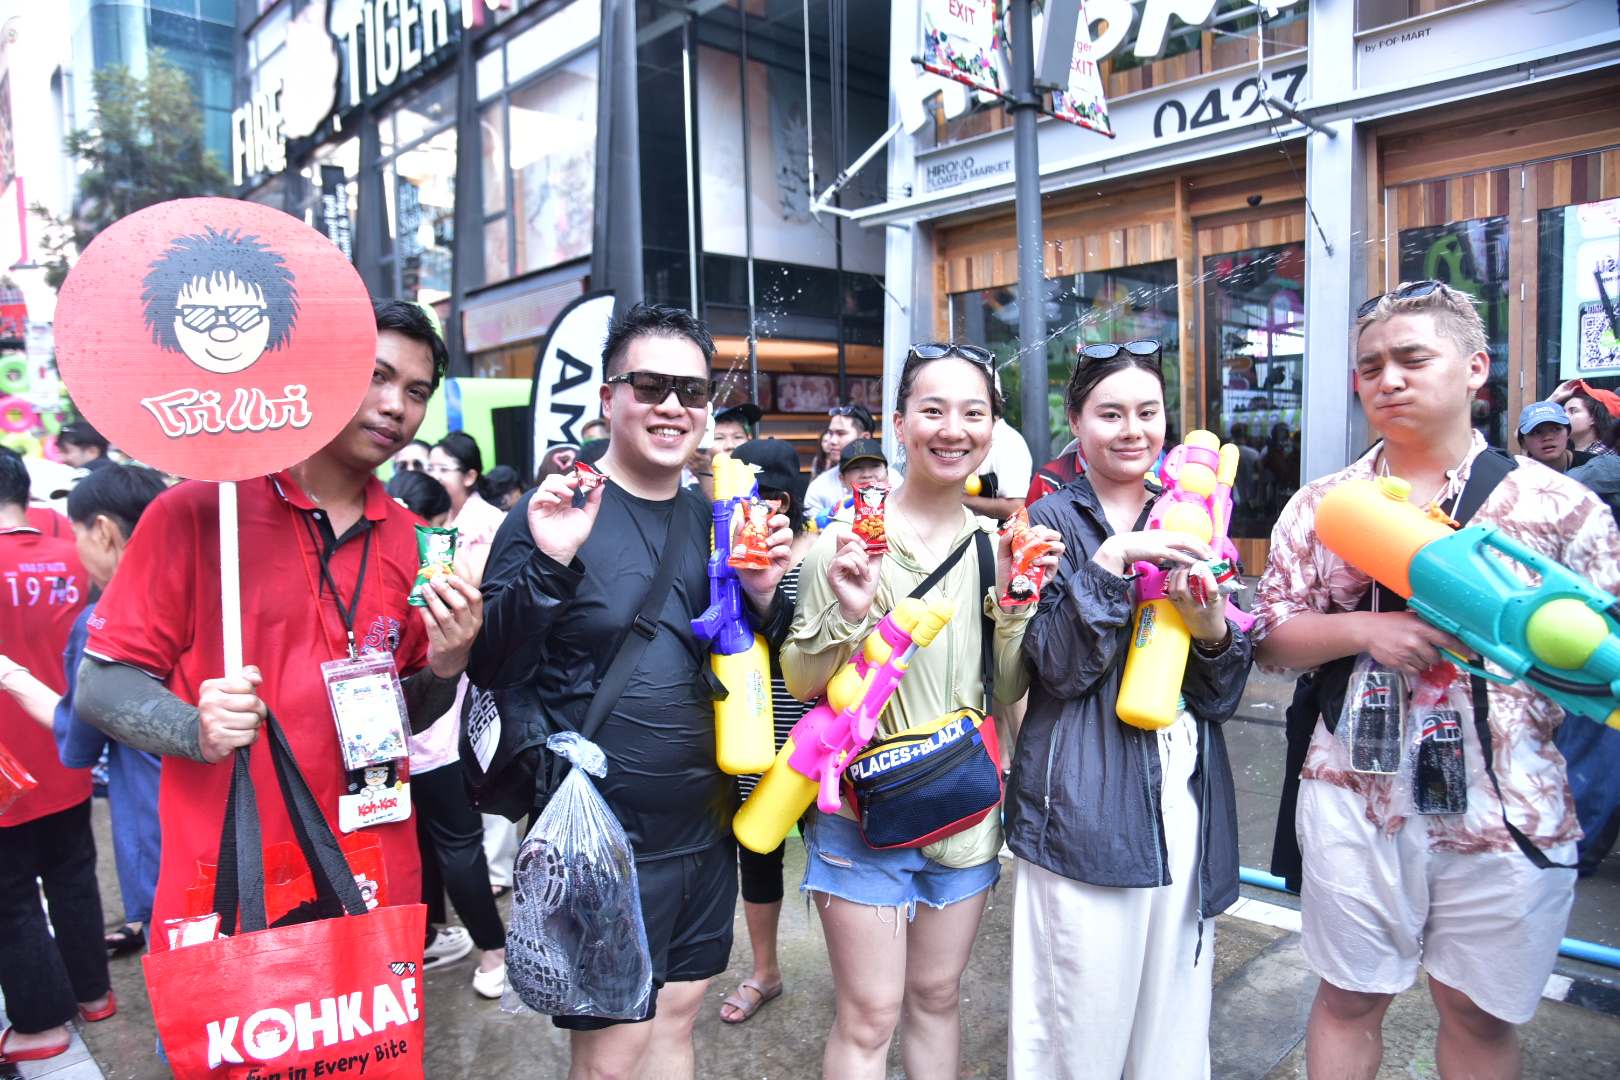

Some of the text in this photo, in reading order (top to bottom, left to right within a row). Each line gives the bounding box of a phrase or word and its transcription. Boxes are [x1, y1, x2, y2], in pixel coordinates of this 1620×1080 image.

[949, 2, 976, 25] EXIT
[1401, 27, 1432, 44] MART
[1153, 64, 1308, 139] 0427
[926, 156, 975, 178] HIRONO
[969, 159, 1011, 179] MARKET
[206, 977, 420, 1071] KOHKAE
[314, 1052, 370, 1075] Every
[375, 1037, 408, 1062] Bite
